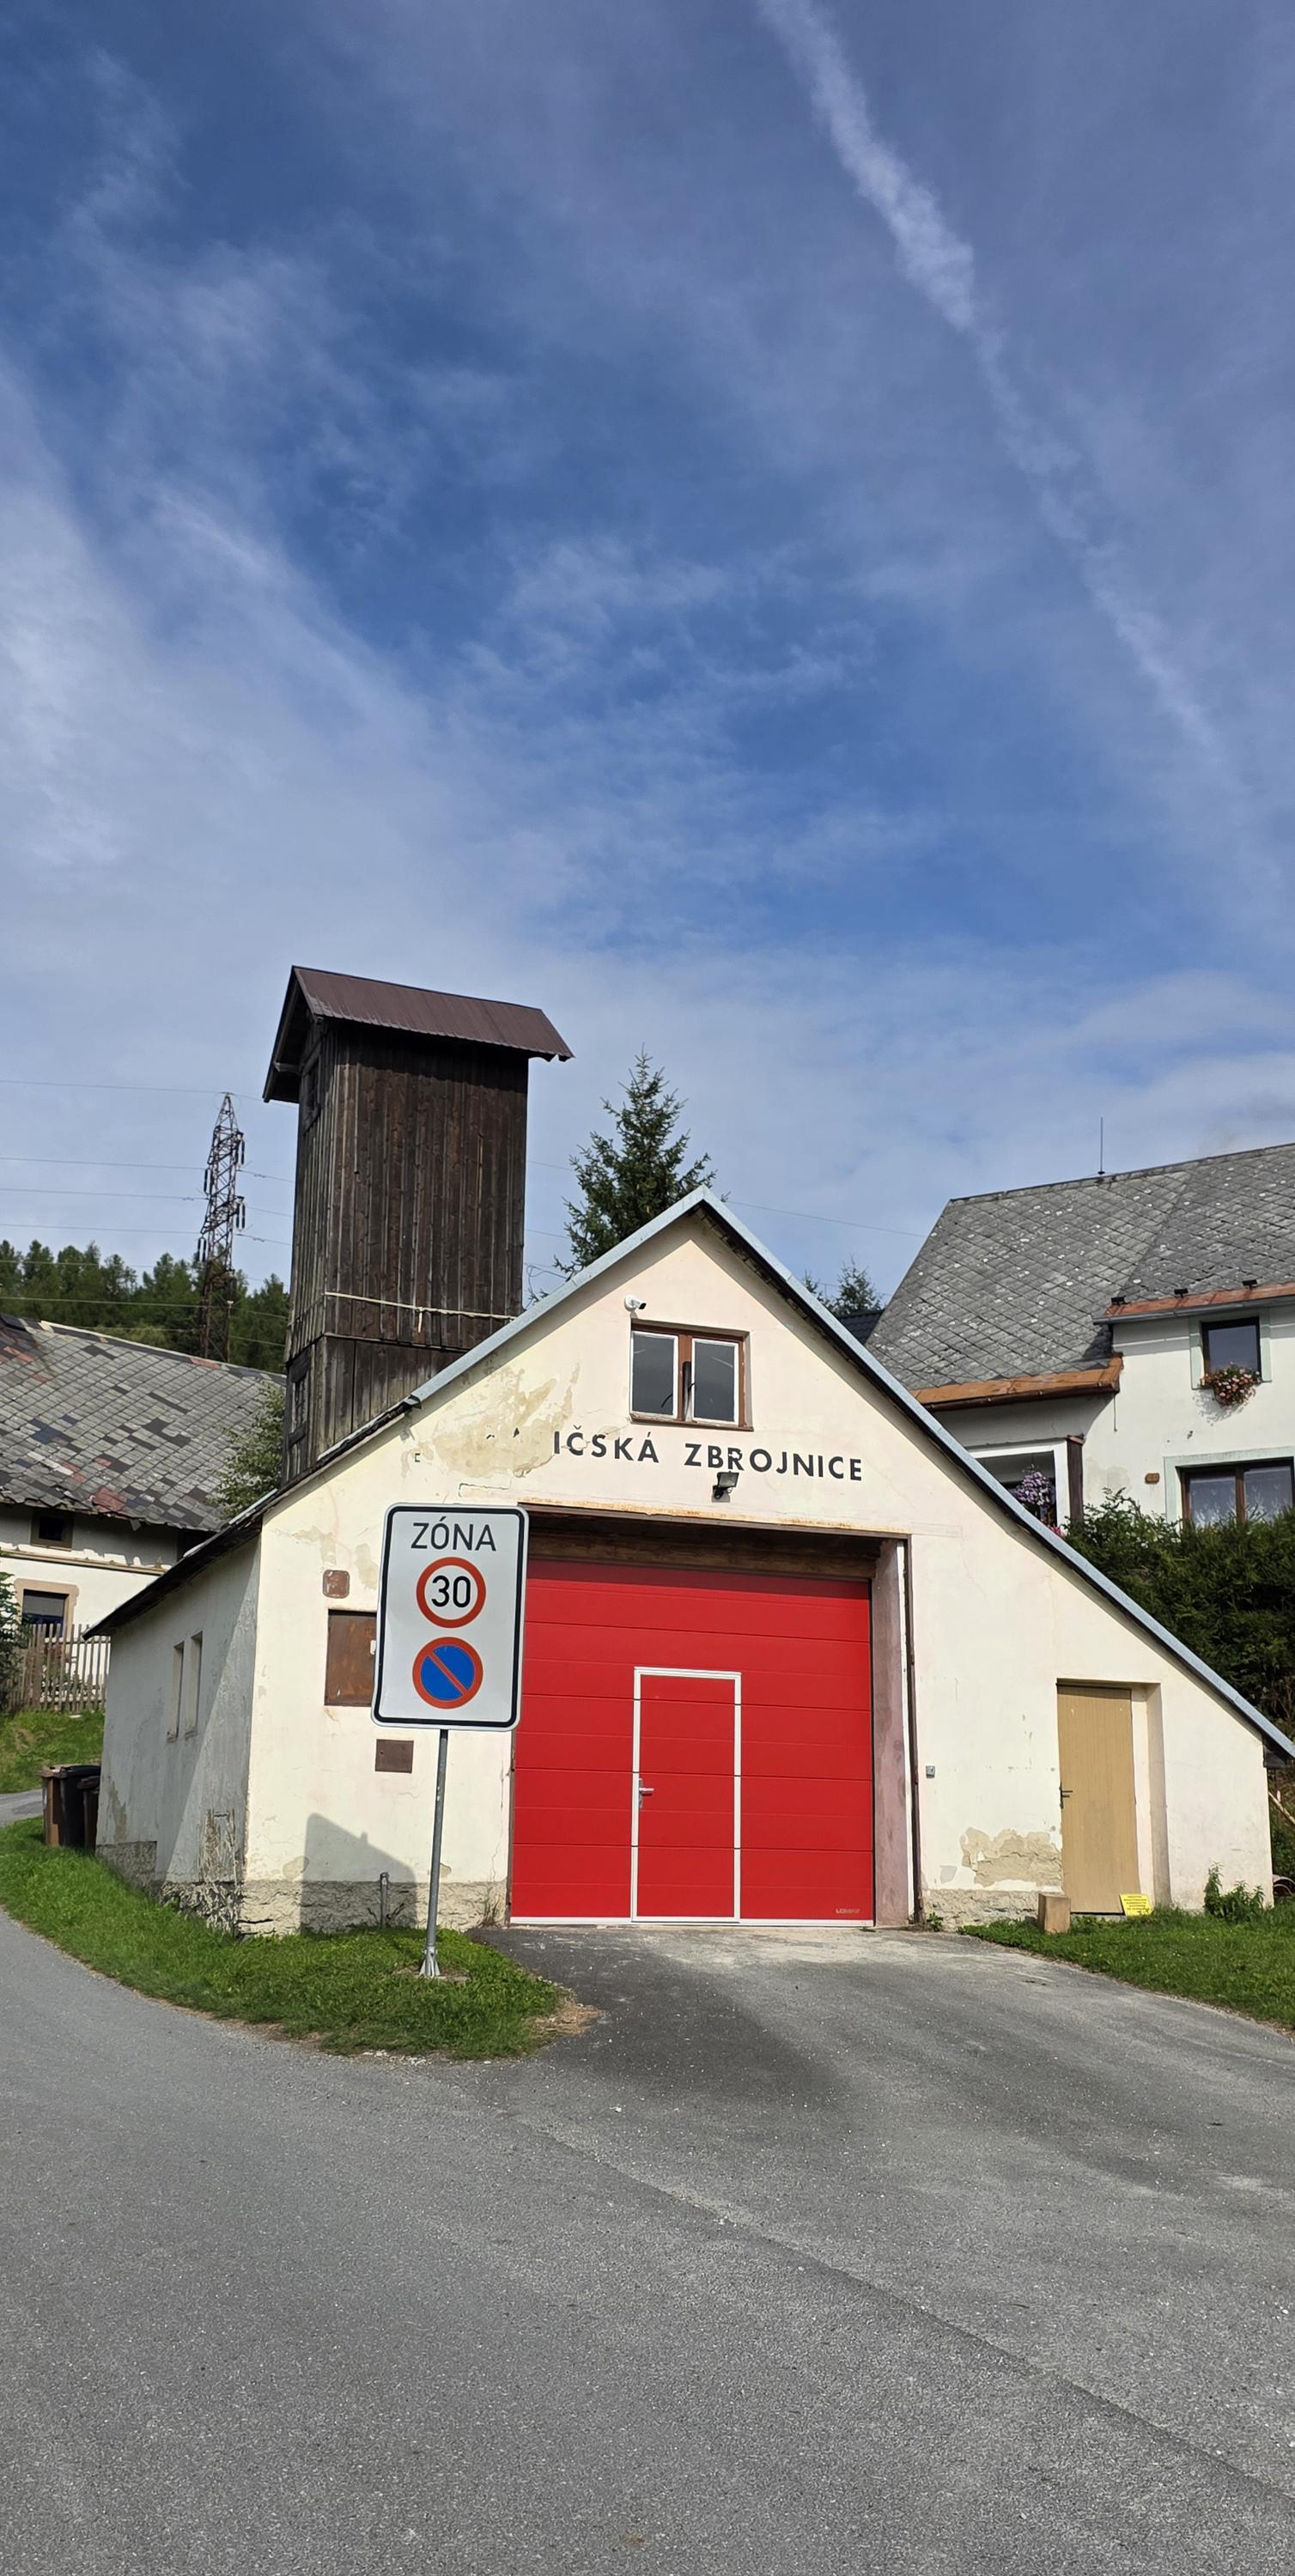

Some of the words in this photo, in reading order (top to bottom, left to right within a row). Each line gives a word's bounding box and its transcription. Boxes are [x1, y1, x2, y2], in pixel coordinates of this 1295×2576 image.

[684, 1443, 862, 1481] ZBROJNICE
[410, 1516, 496, 1552] ZÓNA
[431, 1576, 471, 1607] 30
